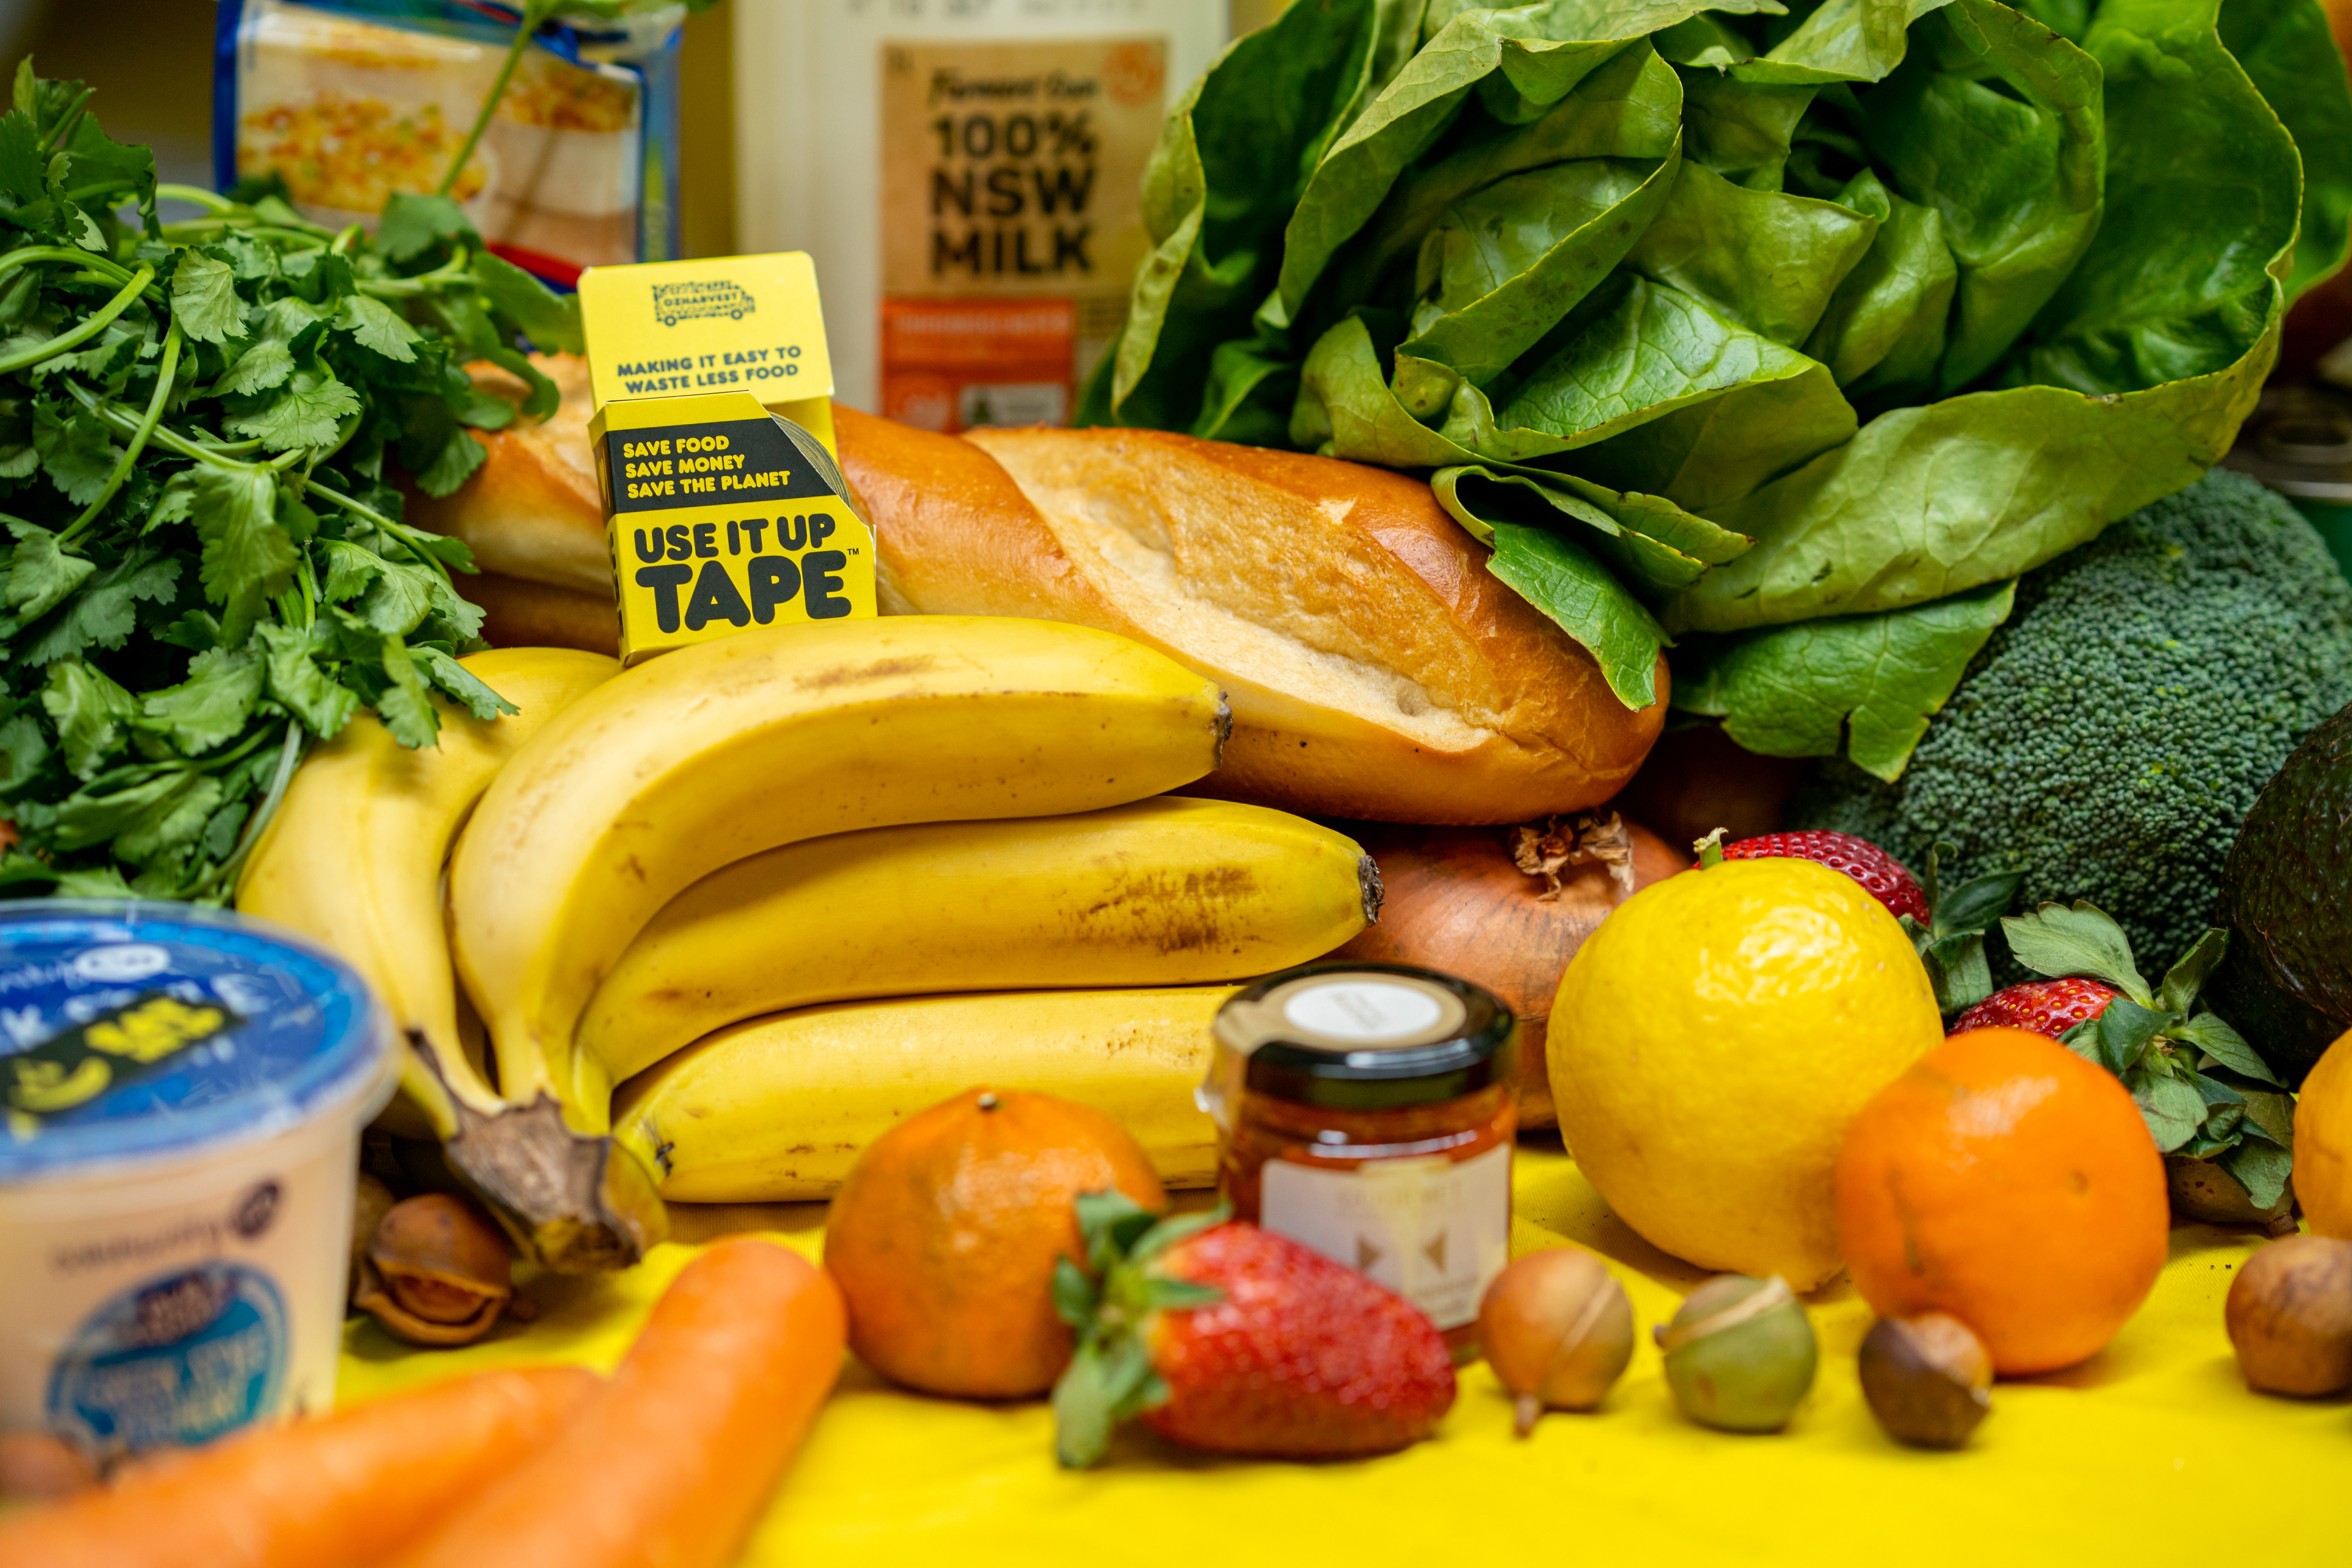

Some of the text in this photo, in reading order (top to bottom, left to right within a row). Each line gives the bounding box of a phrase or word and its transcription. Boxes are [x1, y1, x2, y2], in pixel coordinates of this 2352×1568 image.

[935, 114, 1094, 158] 100%
[933, 168, 1096, 217] NSW
[934, 225, 1093, 274] MILK
[663, 292, 737, 307] OZHARVEST
[617, 346, 801, 377] MAKING IT EASY TO
[624, 364, 799, 394] WASTE LESS FOOD
[623, 435, 730, 458] SAVE FOOD
[625, 454, 745, 478] SAVE MONEY
[628, 470, 790, 499] SAVE THE PLANET
[634, 513, 836, 563] USE IT UP
[635, 550, 851, 633] TAPE
